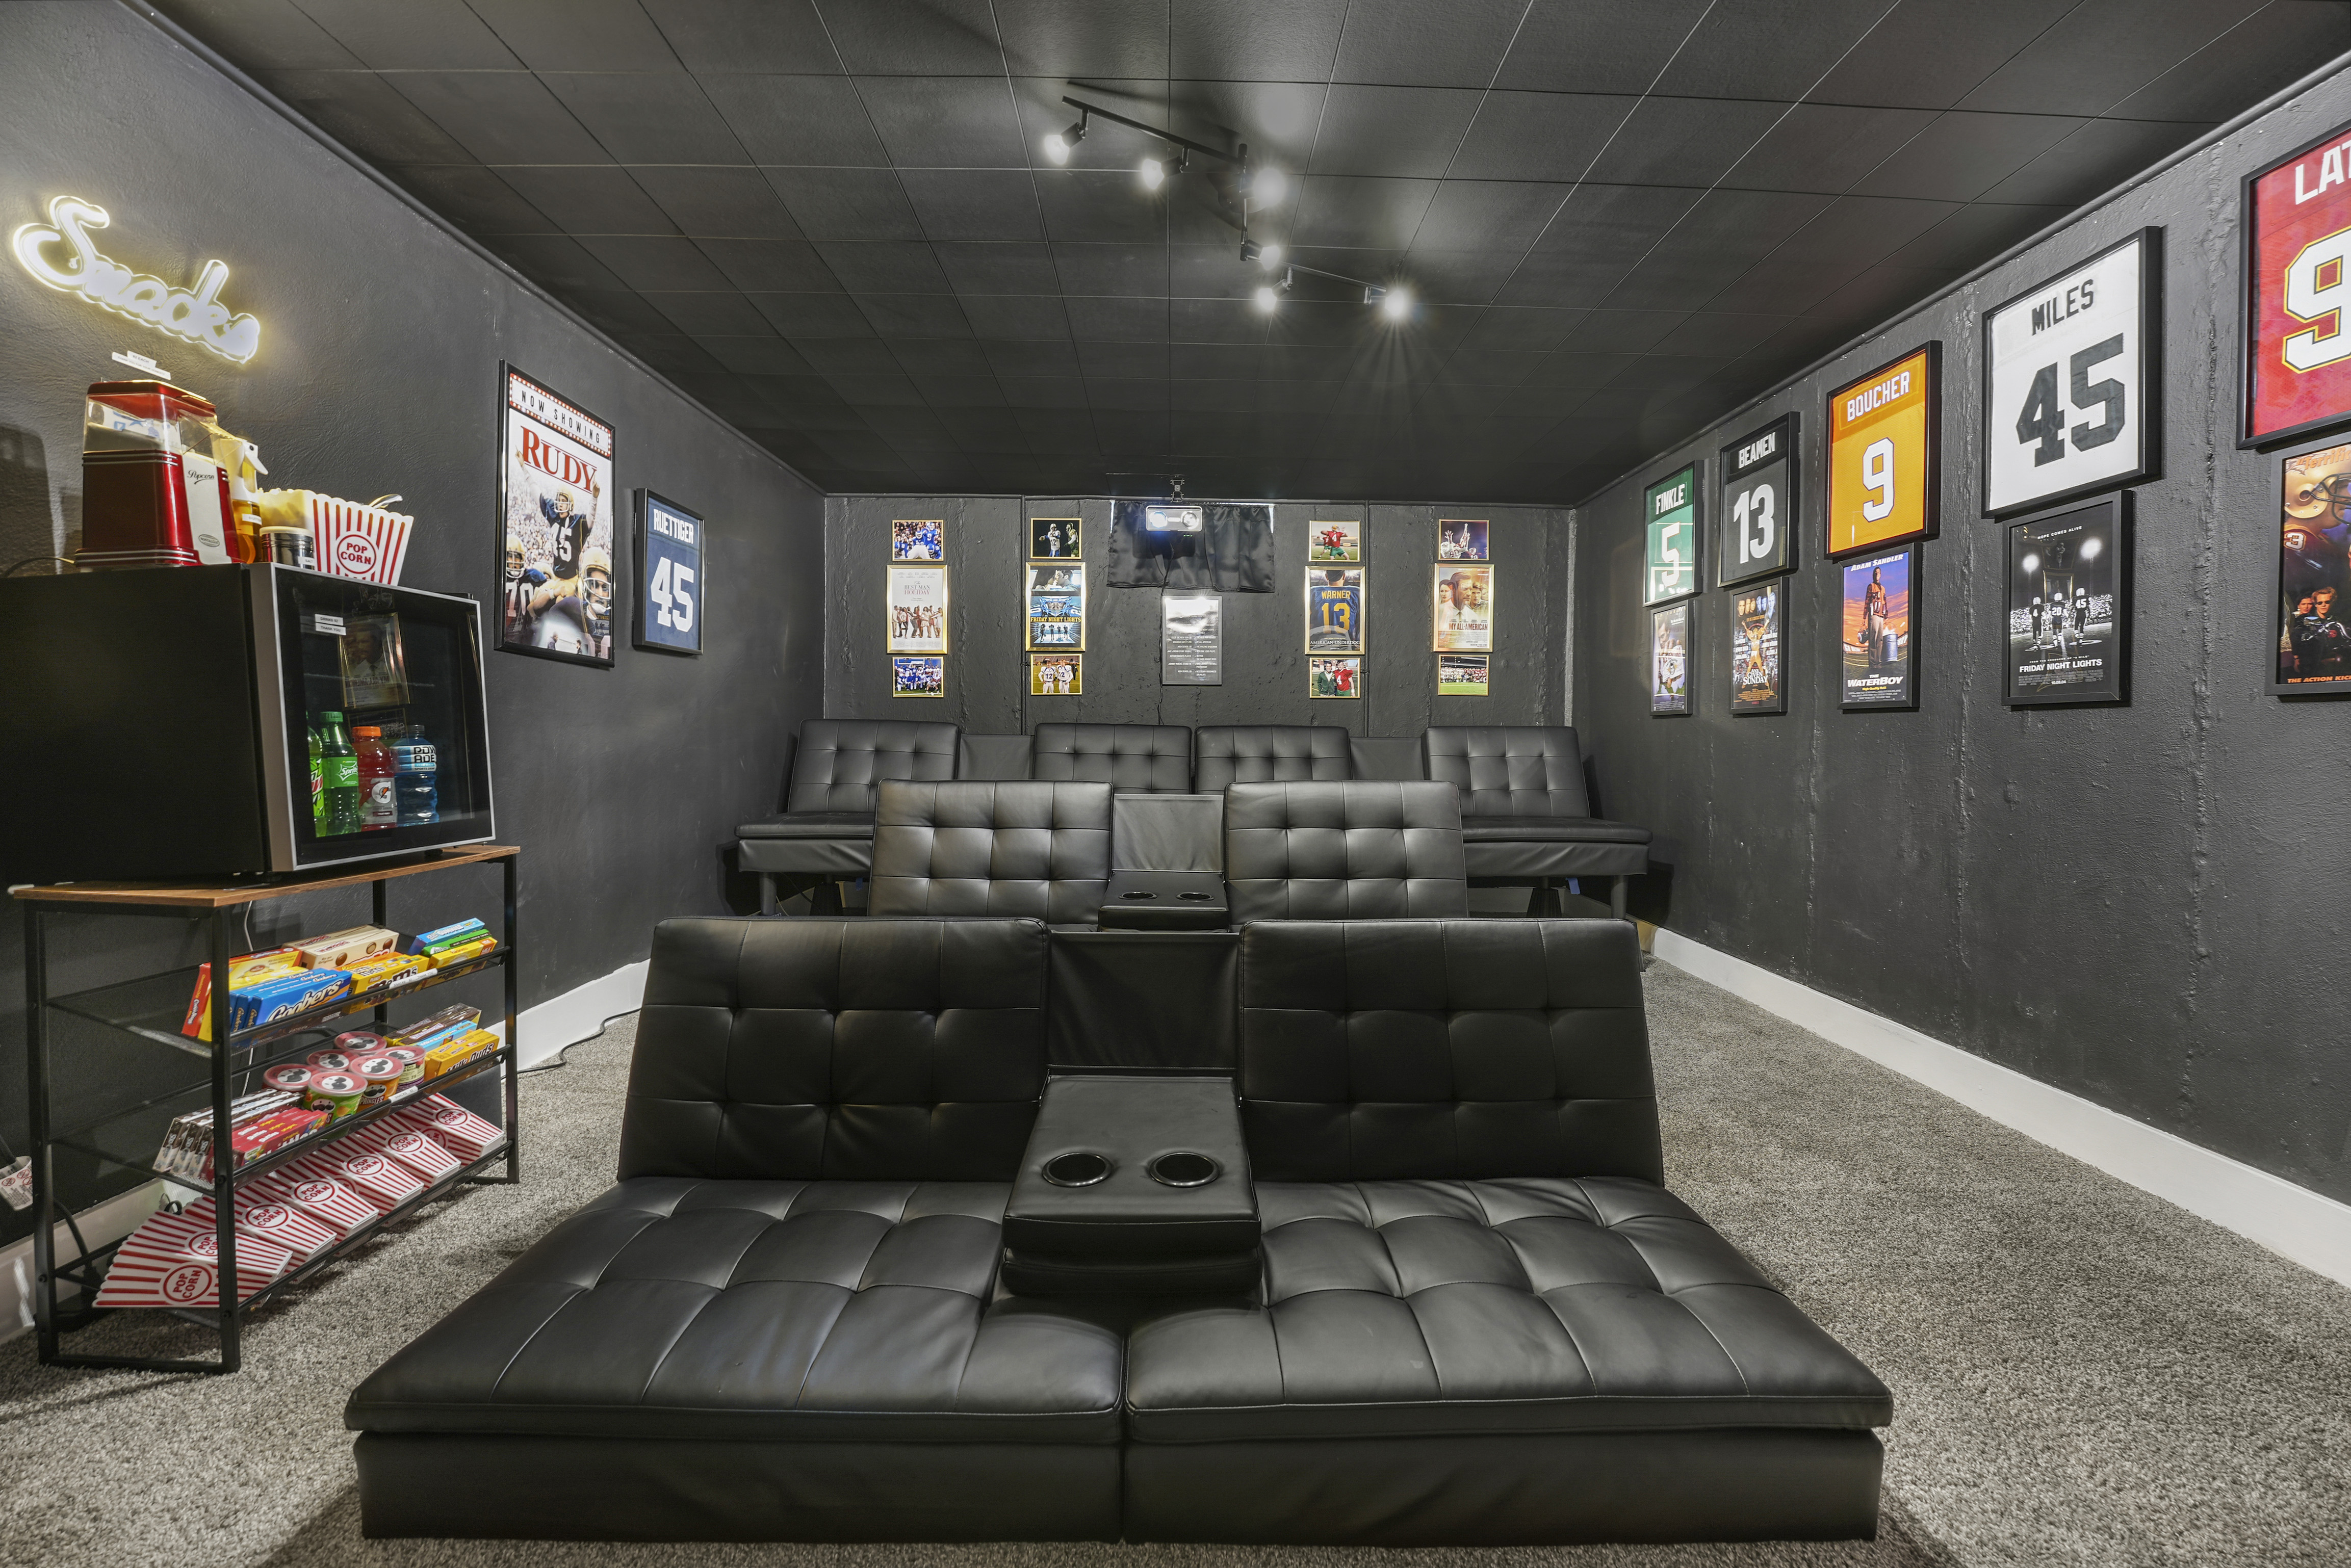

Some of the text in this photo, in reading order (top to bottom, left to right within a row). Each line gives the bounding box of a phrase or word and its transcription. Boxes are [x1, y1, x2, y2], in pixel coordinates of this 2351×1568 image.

[2032, 280, 2095, 337] MILES
[2282, 227, 2351, 374] 9
[1847, 370, 1910, 423] BOUCHER
[2016, 333, 2126, 468] 45
[522, 390, 600, 444] NOW SHOWING
[1738, 432, 1775, 469] BEAMEN
[521, 426, 597, 494] RUDY
[187, 469, 214, 481] Popcorn
[1863, 437, 1895, 523] 9
[1656, 483, 1685, 514] FINKLE
[653, 508, 694, 545] RUETTIGER
[1734, 483, 1775, 564] 13
[1332, 534, 1337, 542] 4
[347, 542, 368, 554] POP
[1661, 522, 1681, 588] 5
[340, 551, 371, 565] CORN
[1850, 554, 1904, 572] ADAM SANDLER
[651, 556, 694, 633] 45
[1321, 590, 1351, 599] WARNER
[2052, 607, 2062, 616] 20
[2076, 598, 2087, 609] 45
[1322, 603, 1350, 634] 13
[2020, 659, 2102, 673] FRIDAY NIGHT LIGHTS
[1743, 675, 1768, 685] SUNDAY
[1847, 676, 1903, 687] WATERBOY
[372, 781, 392, 804] G
[268, 980, 343, 1022] Goobers
[359, 1096, 385, 1105] PRINGLES
[445, 1112, 464, 1124] CORN
[394, 1136, 408, 1146] POP
[397, 1138, 419, 1151] CORN
[353, 1158, 369, 1168] POP
[356, 1160, 379, 1173] CORN
[301, 1184, 319, 1195] POP
[304, 1185, 331, 1200] CORN
[253, 1208, 270, 1220] POP
[257, 1209, 283, 1226] CORN
[198, 1237, 212, 1250] POP
[205, 1239, 218, 1255] COR
[173, 1273, 189, 1293] POP
[183, 1270, 202, 1298] CORN
